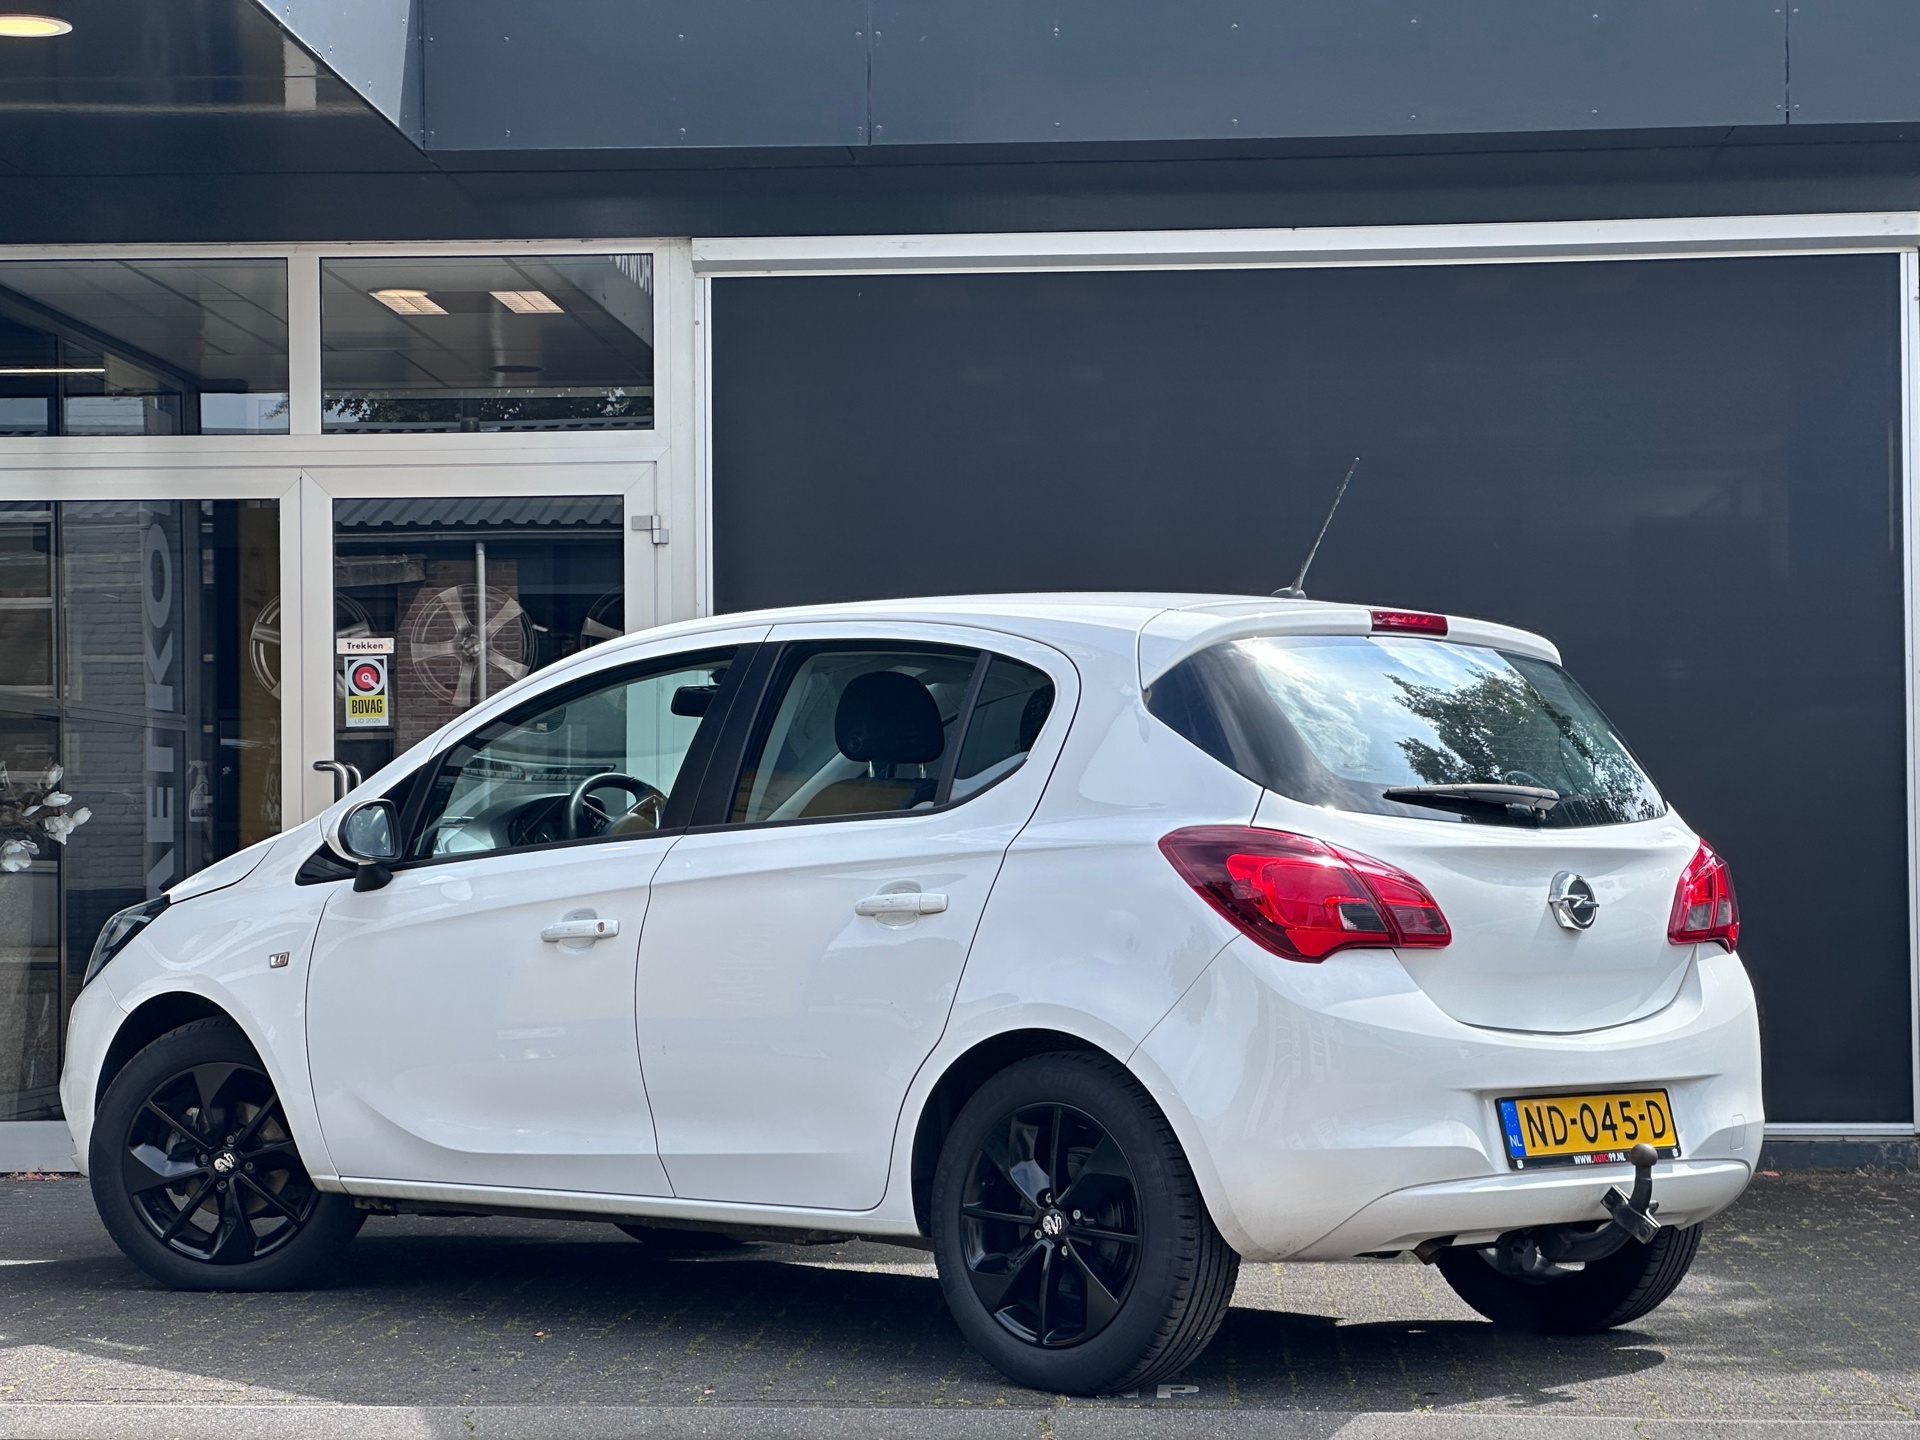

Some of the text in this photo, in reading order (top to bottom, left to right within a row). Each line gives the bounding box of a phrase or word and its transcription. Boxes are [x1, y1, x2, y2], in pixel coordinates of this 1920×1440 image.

[347, 641, 384, 650] Trekken
[352, 699, 383, 714] BOVAG
[1524, 1100, 1666, 1148] ND-045-D
[1509, 1135, 1523, 1148] NL
